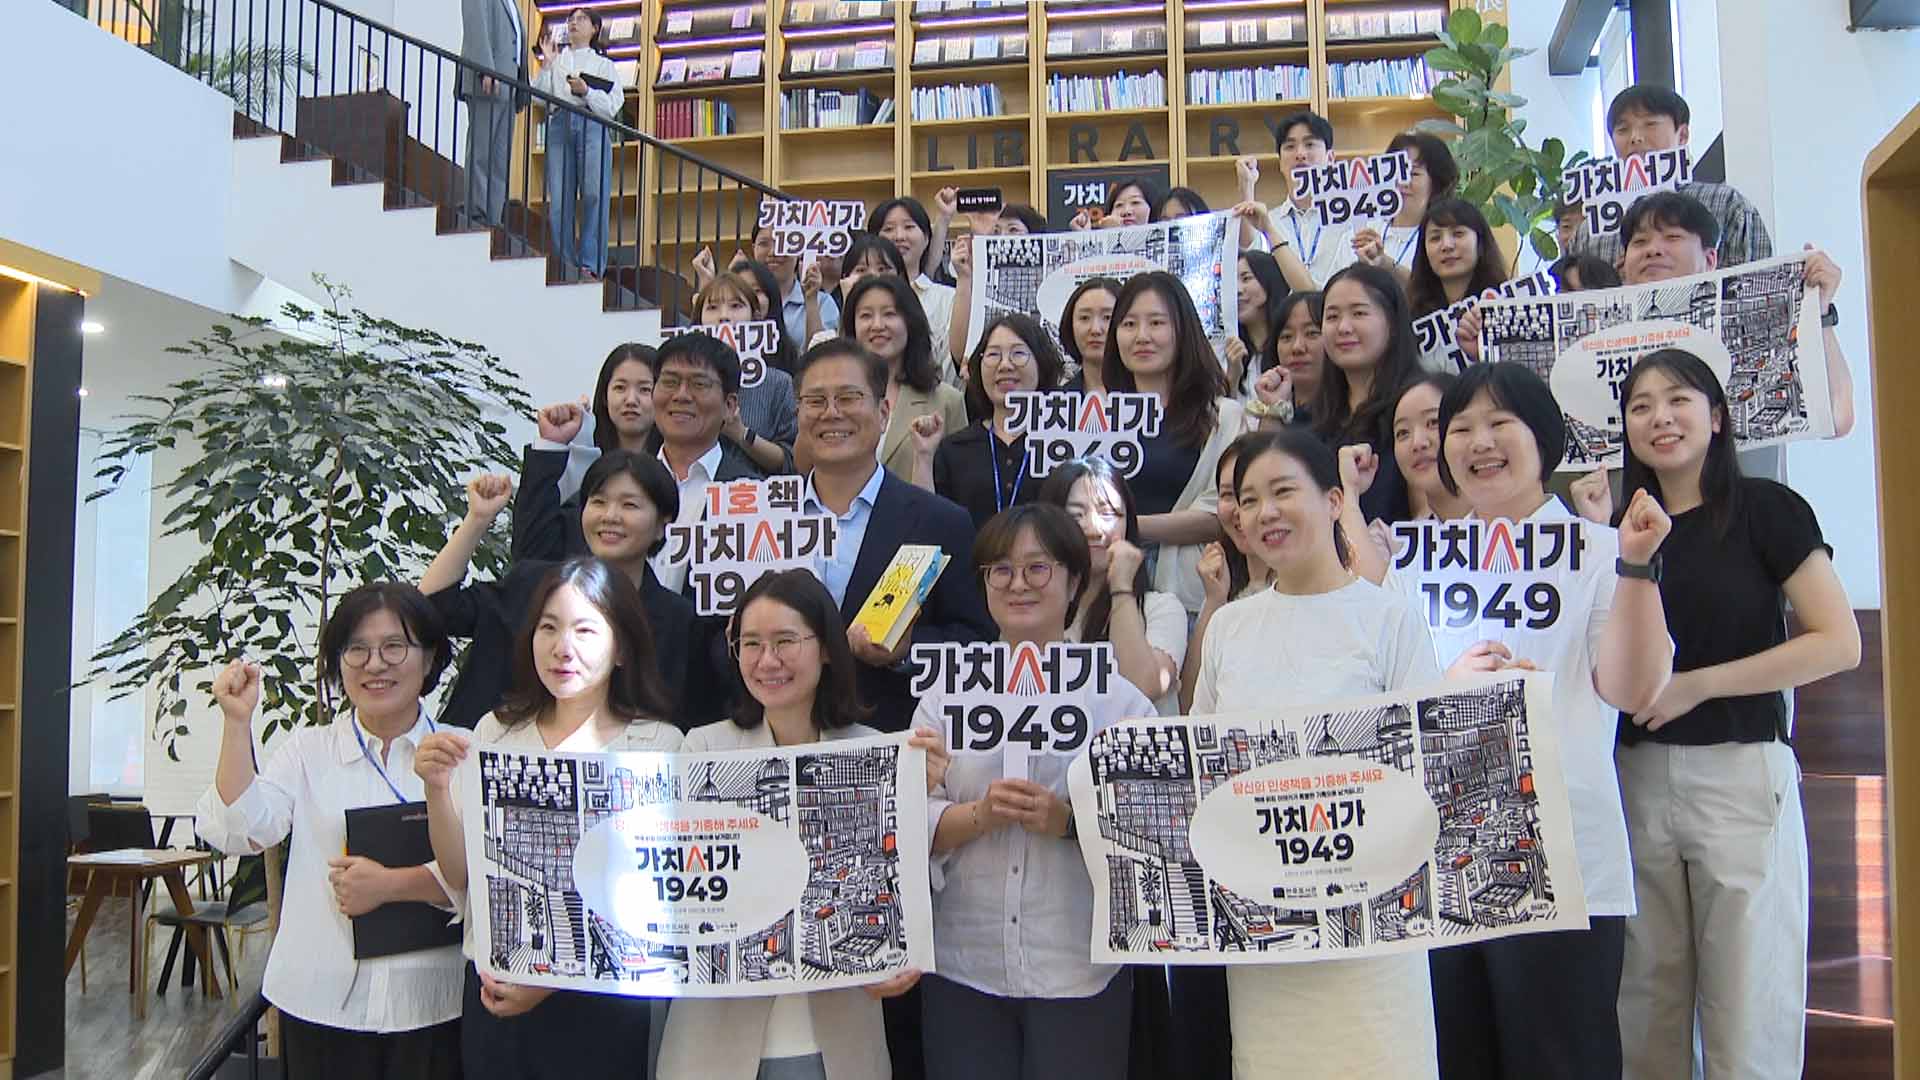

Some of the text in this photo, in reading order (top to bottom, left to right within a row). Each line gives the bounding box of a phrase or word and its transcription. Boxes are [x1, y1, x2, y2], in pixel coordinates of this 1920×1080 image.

[1294, 154, 1409, 196] 가치서가
[1564, 149, 1690, 201] 가치서가
[1063, 183, 1106, 206] 가치
[1315, 189, 1399, 226] 1949
[761, 202, 863, 227] 가치서가
[1586, 201, 1623, 234] 19
[774, 231, 849, 255] 1949
[1008, 395, 1158, 434] 가치서가
[706, 481, 799, 516] 1호 책
[670, 517, 837, 563] 가치서가
[1395, 522, 1585, 573] 가치서가
[695, 571, 744, 611] 19
[1422, 582, 1561, 630] 1949
[916, 647, 1112, 696] 가치서가
[944, 705, 1088, 751] 1949
[1256, 799, 1365, 834] 가치서가
[636, 845, 741, 872] 가치서가
[1275, 833, 1354, 865] 1949
[653, 875, 728, 902] 1949
